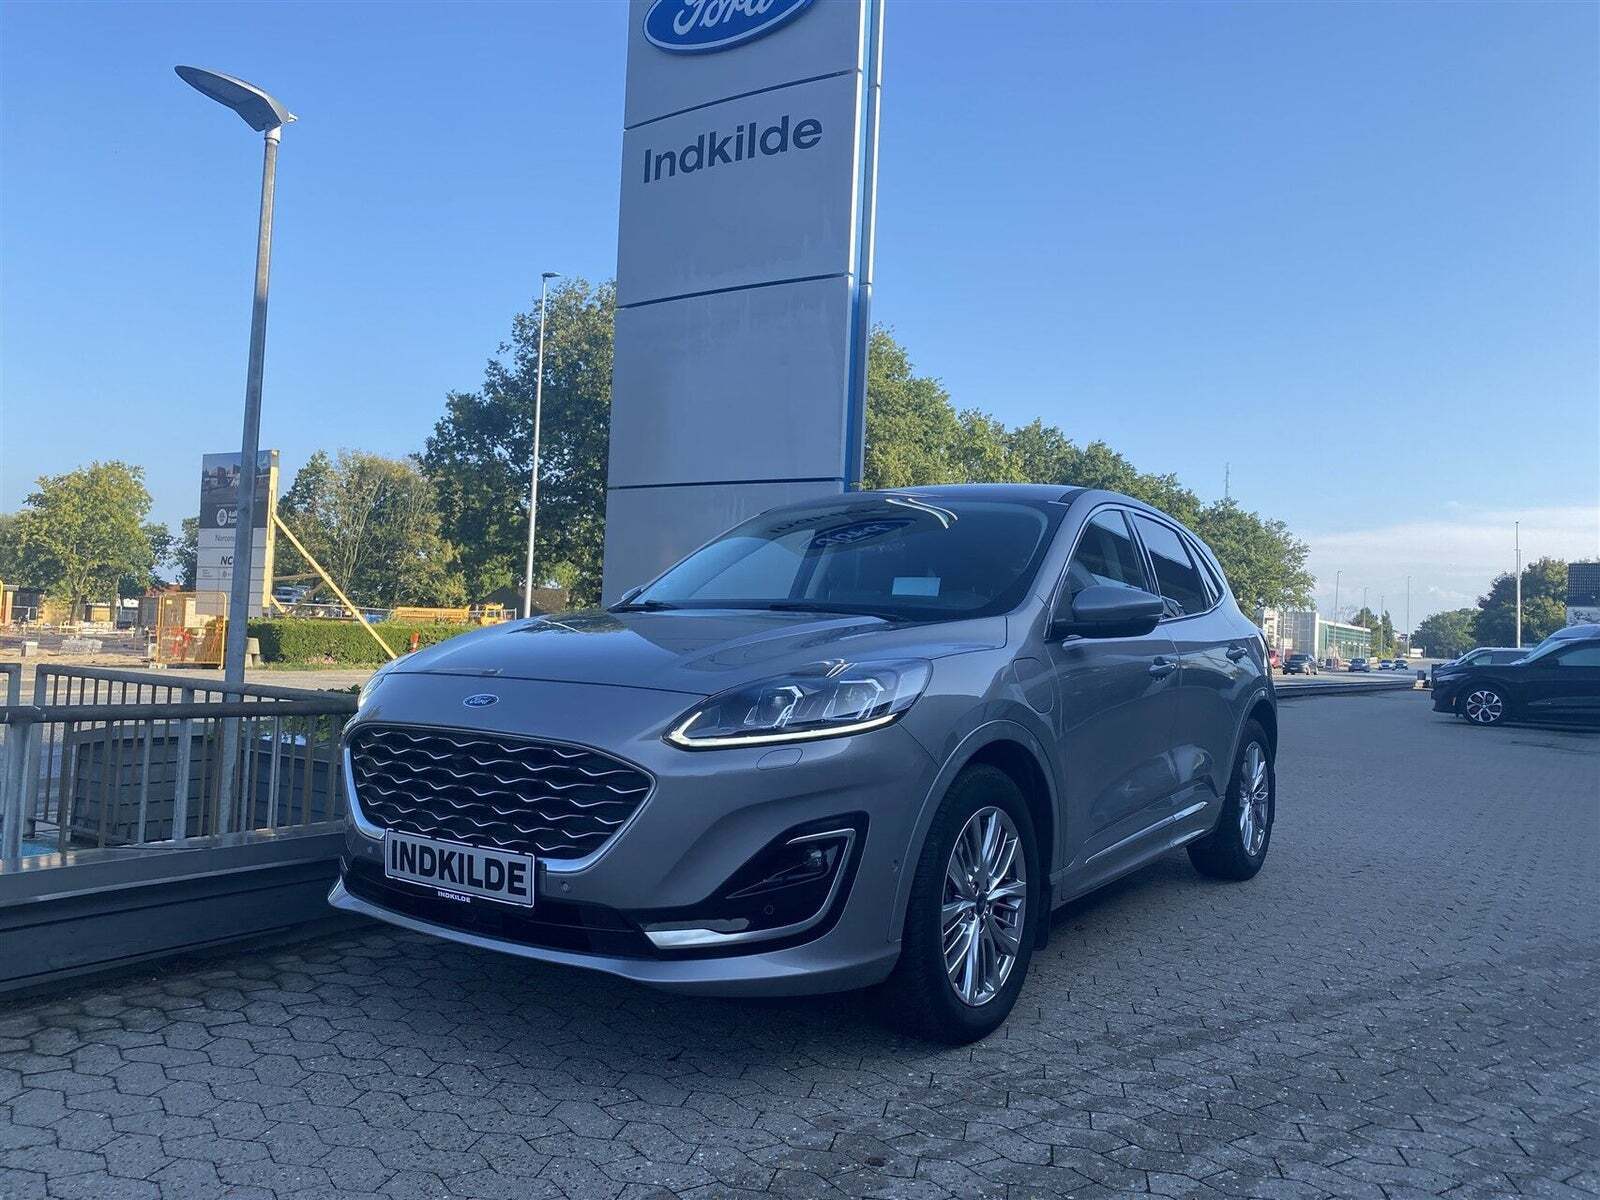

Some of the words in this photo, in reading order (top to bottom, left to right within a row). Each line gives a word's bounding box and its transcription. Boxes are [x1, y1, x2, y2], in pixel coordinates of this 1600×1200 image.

[643, 115, 823, 184] Indkilde
[391, 839, 527, 897] INDKILDE
[437, 890, 471, 903] INDKILDE
